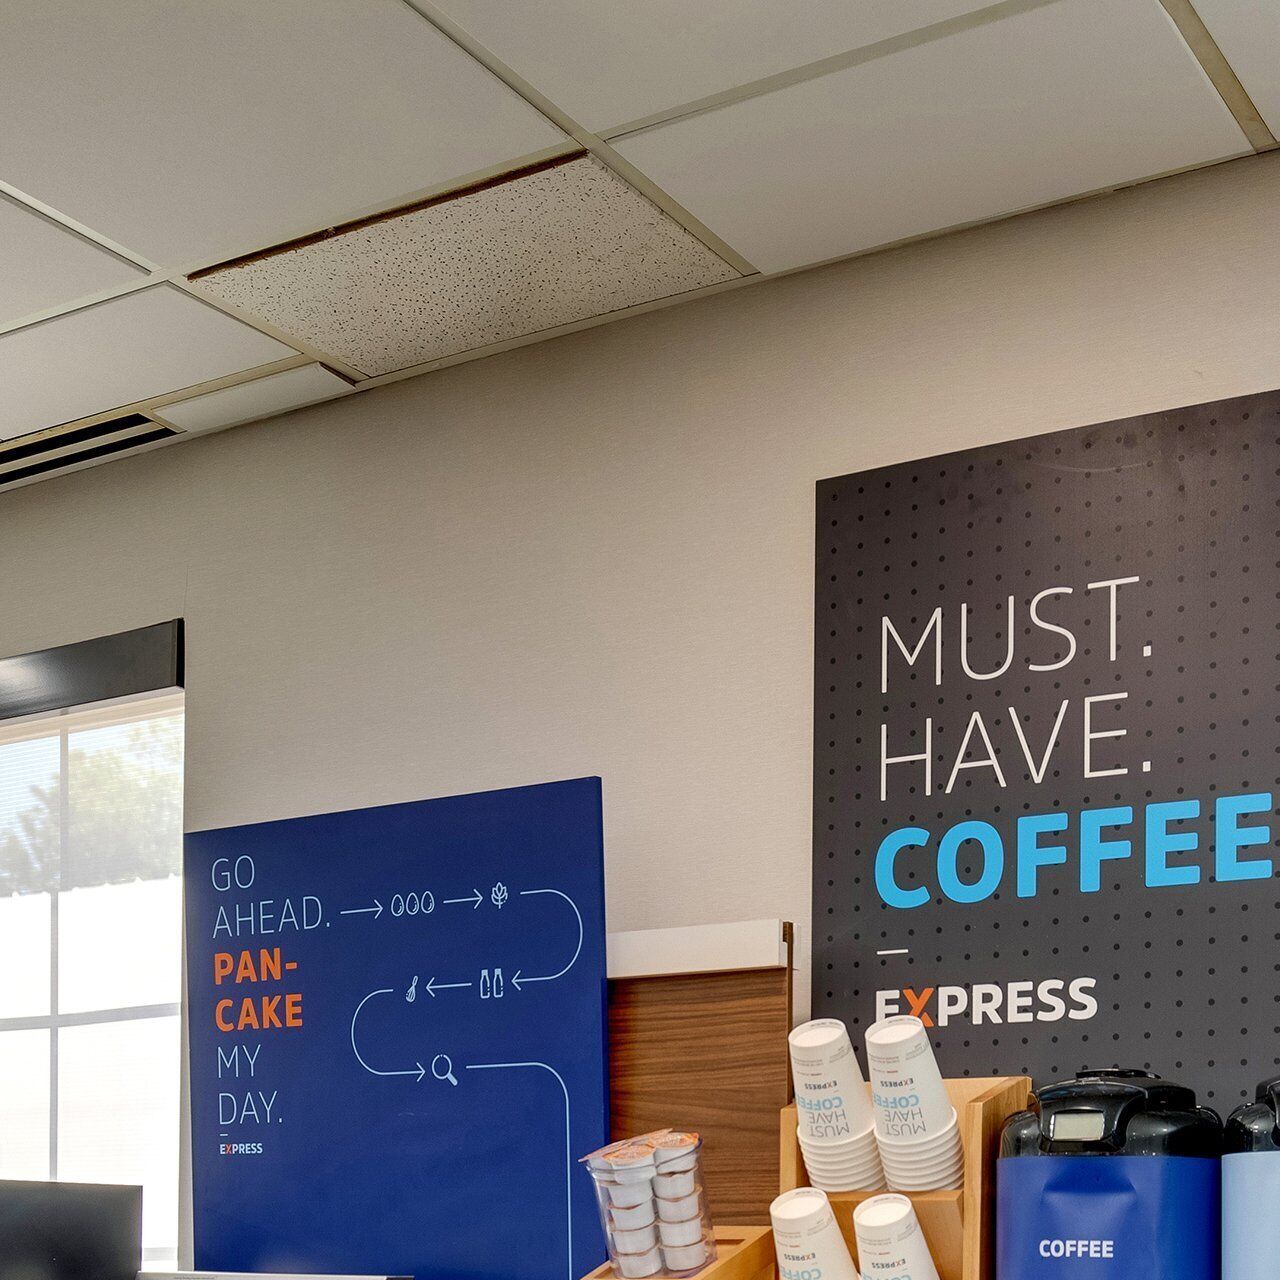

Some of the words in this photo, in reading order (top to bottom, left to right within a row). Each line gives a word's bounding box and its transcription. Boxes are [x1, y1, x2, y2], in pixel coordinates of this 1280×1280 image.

[881, 576, 1152, 694] MUST.
[881, 692, 1152, 801] HAVE.
[211, 855, 255, 891] GO
[213, 896, 330, 939] AHEAD.
[214, 947, 298, 985] PAN-
[215, 994, 303, 1032] CAKE
[875, 977, 1098, 1028] EXPRESS
[217, 1044, 261, 1078] MY
[804, 1080, 838, 1090] EXPRESS
[880, 1077, 914, 1089] EXPRESS
[219, 1090, 283, 1125] DAY.
[219, 1142, 263, 1155] EXPRESS
[783, 1252, 816, 1262] EXPRESS
[871, 1258, 907, 1269] EXPRESS
[1039, 1239, 1114, 1258] COFFEE
